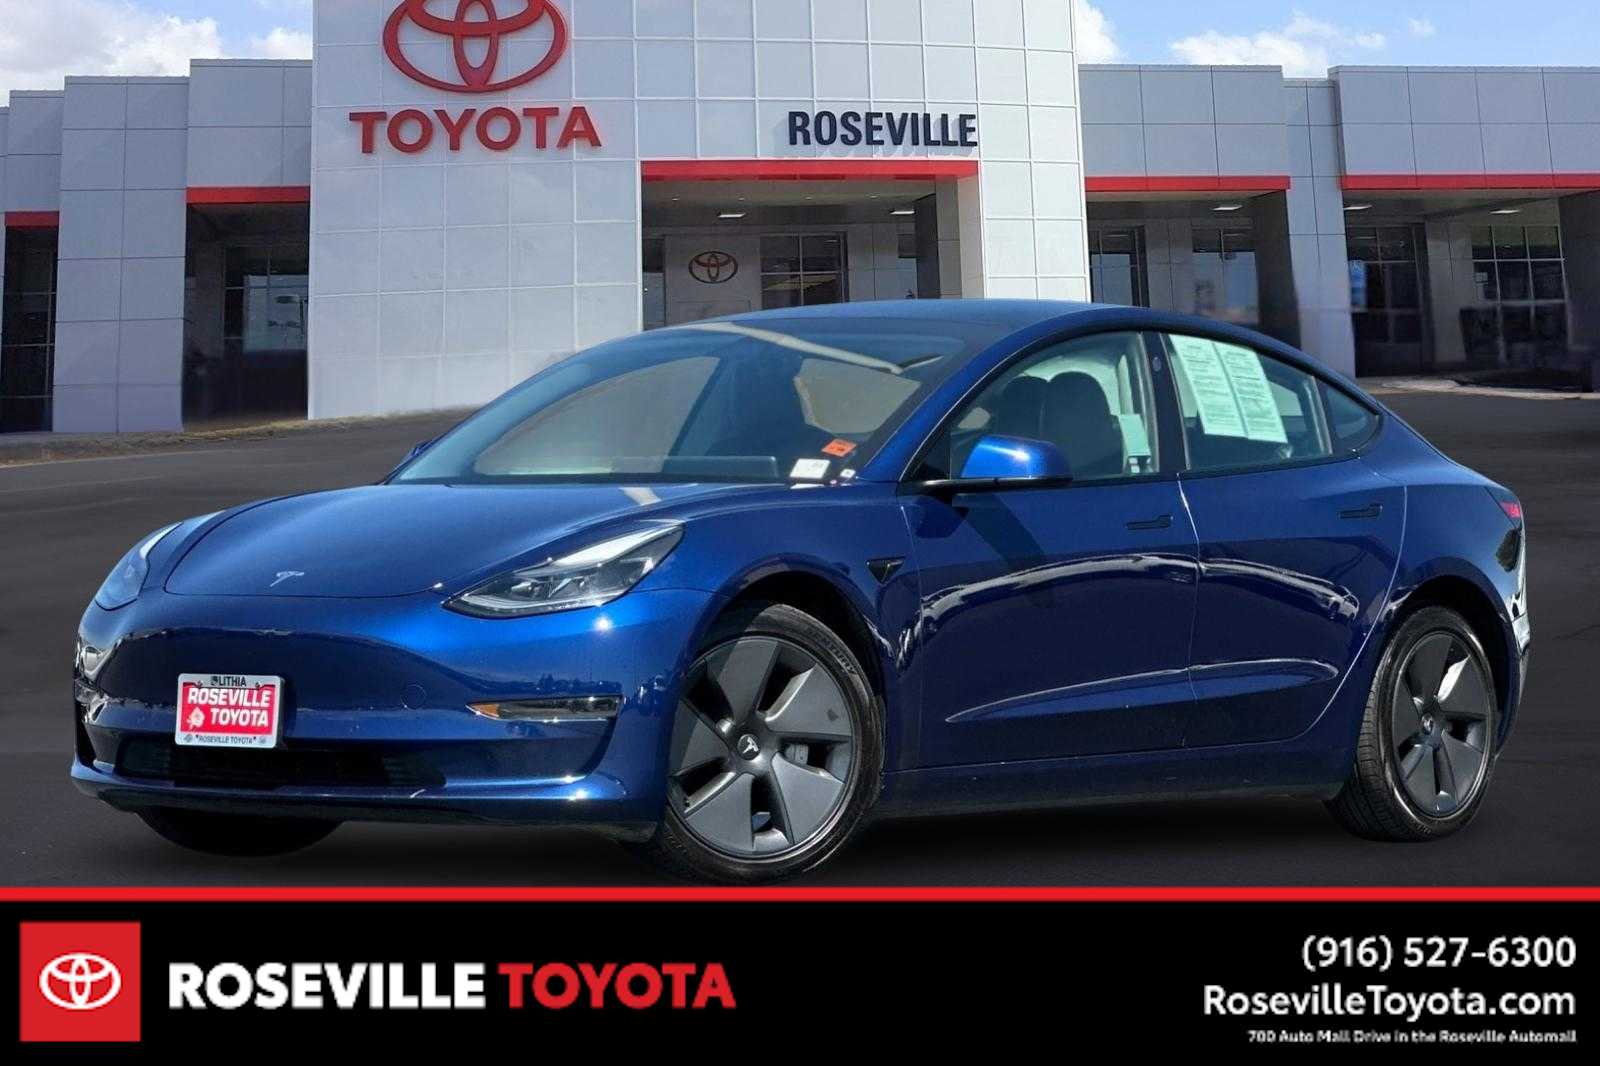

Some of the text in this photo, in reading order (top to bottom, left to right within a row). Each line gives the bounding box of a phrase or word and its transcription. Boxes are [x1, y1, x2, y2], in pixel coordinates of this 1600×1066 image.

[349, 106, 602, 153] TOYOTA
[788, 110, 978, 147] ROSEVILLE
[219, 676, 247, 687] LITHIA
[187, 687, 273, 708] ROSEVILLE
[210, 707, 269, 727] TOYOTA
[198, 735, 253, 745] ROSEVILLE TOYOTA
